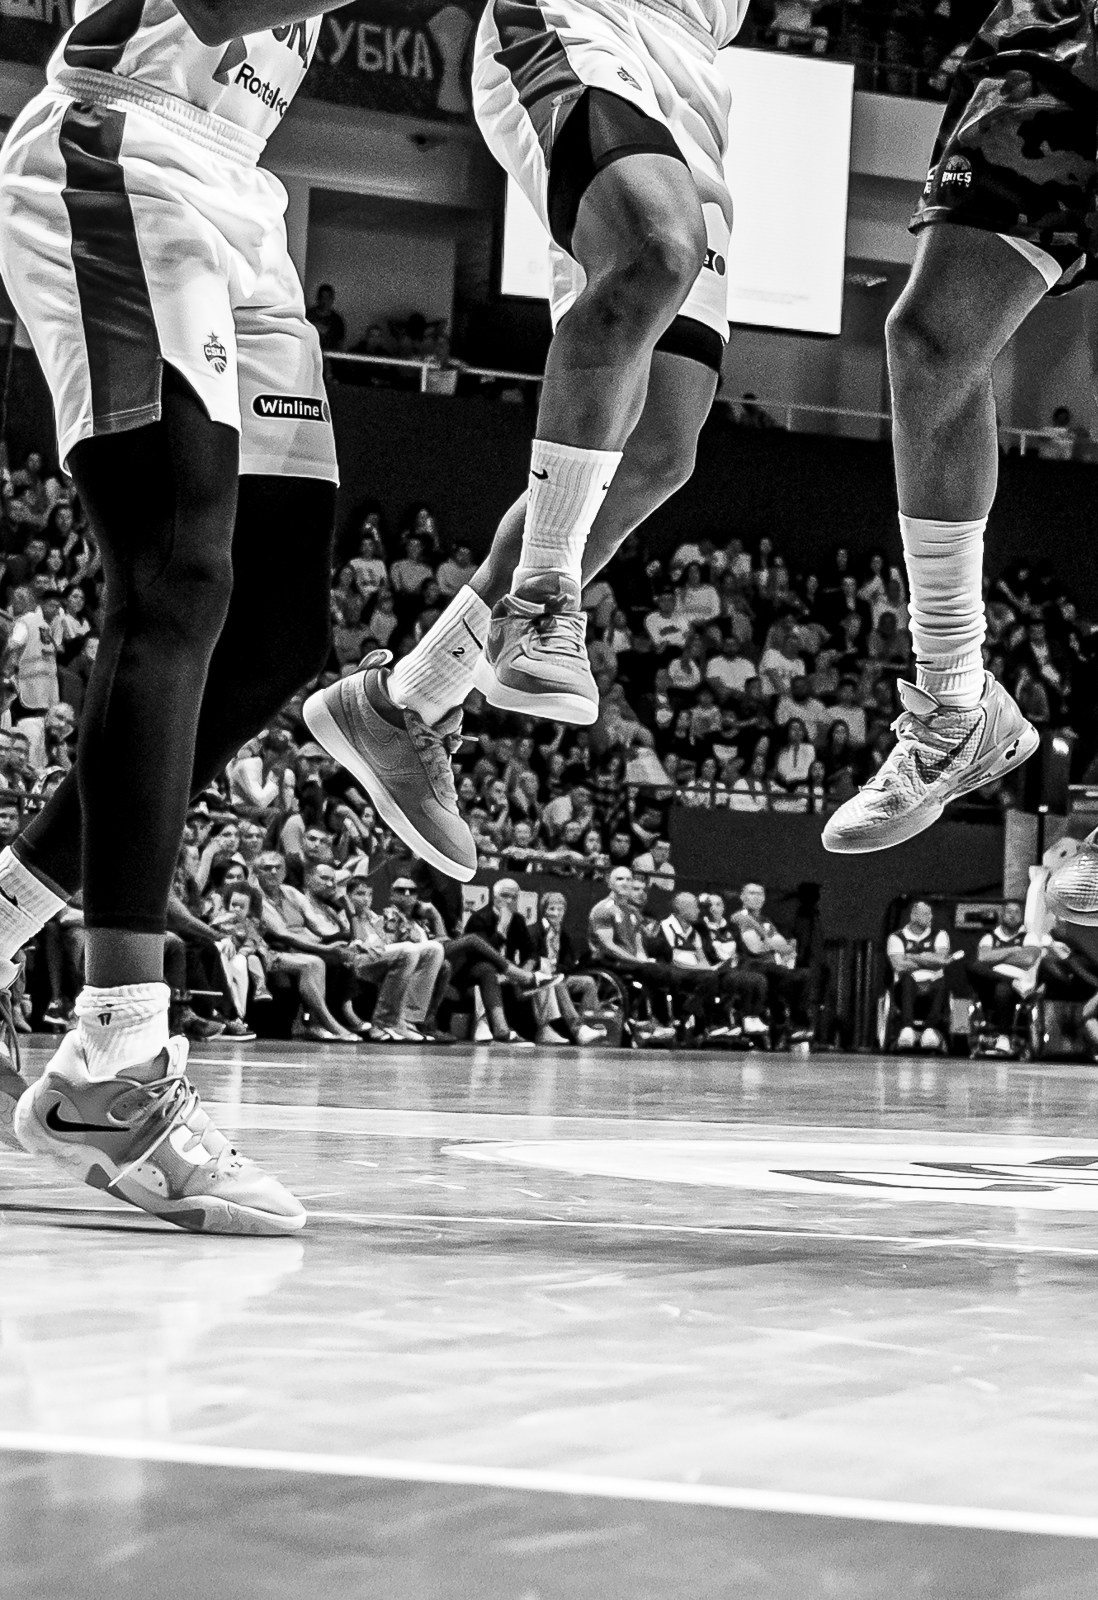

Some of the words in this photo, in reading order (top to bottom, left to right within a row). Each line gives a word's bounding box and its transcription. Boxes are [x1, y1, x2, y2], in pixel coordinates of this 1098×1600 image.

[316, 16, 434, 82] УБКА
[260, 398, 320, 417] Winline
[451, 646, 466, 659] 2
